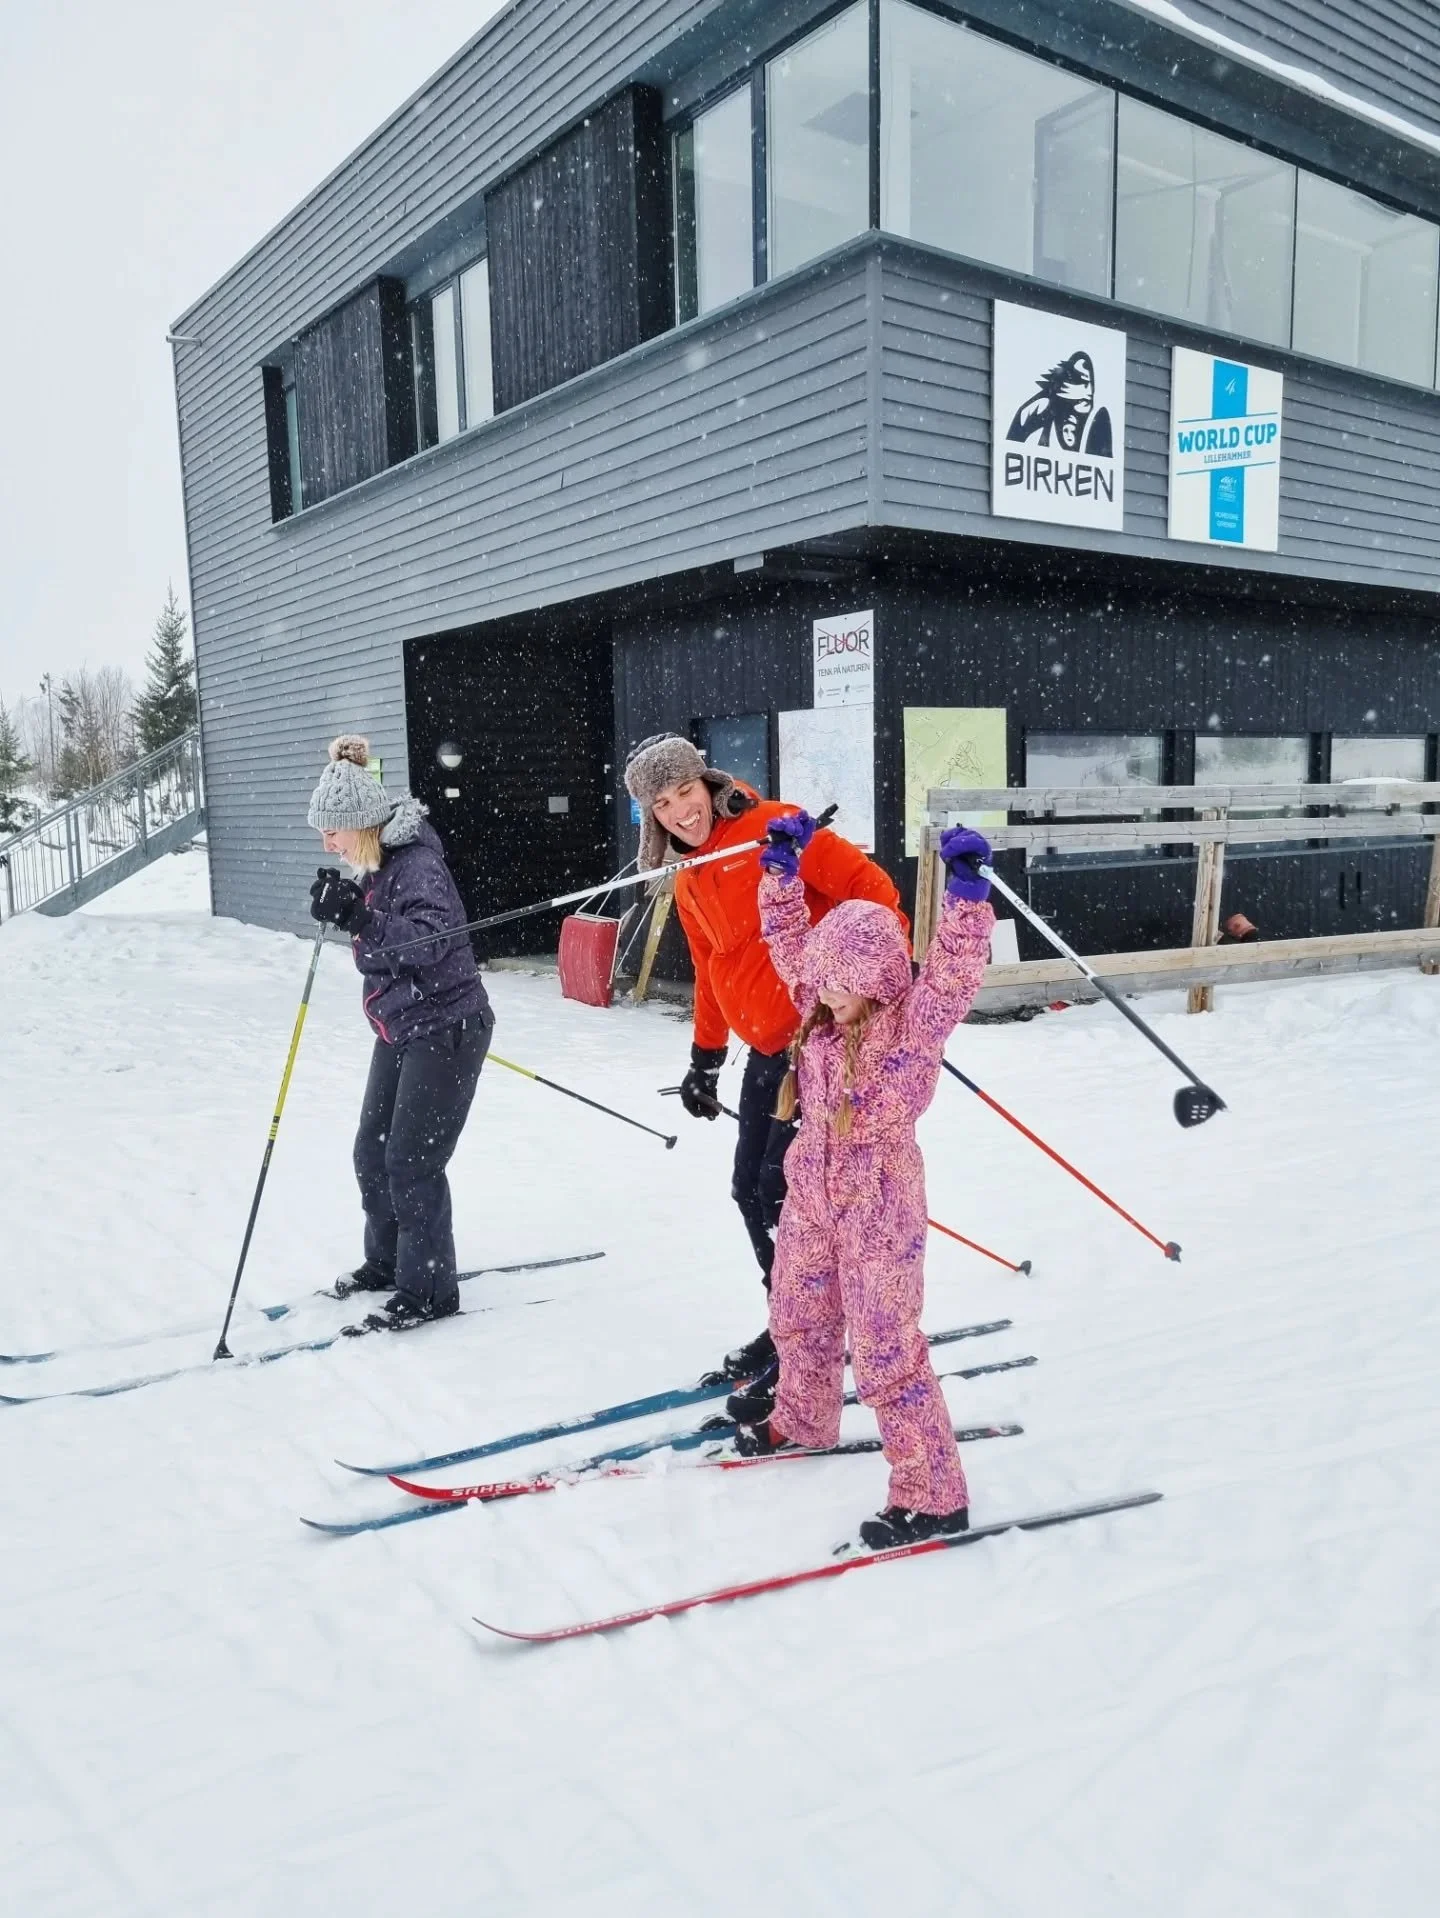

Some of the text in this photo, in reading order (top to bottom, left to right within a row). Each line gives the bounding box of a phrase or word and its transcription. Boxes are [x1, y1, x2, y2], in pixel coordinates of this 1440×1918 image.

[1177, 422, 1278, 453] WORLD CUP
[1203, 450, 1252, 464] LILLEHAMMER
[1004, 452, 1114, 503] BIRKEN
[818, 629, 869, 656] FLUOR
[818, 663, 870, 677] TENK PÅ NATUREN
[665, 859, 693, 873] LEKI
[450, 1478, 550, 1497] MDSHUS
[872, 1548, 912, 1562] MADSHUS
